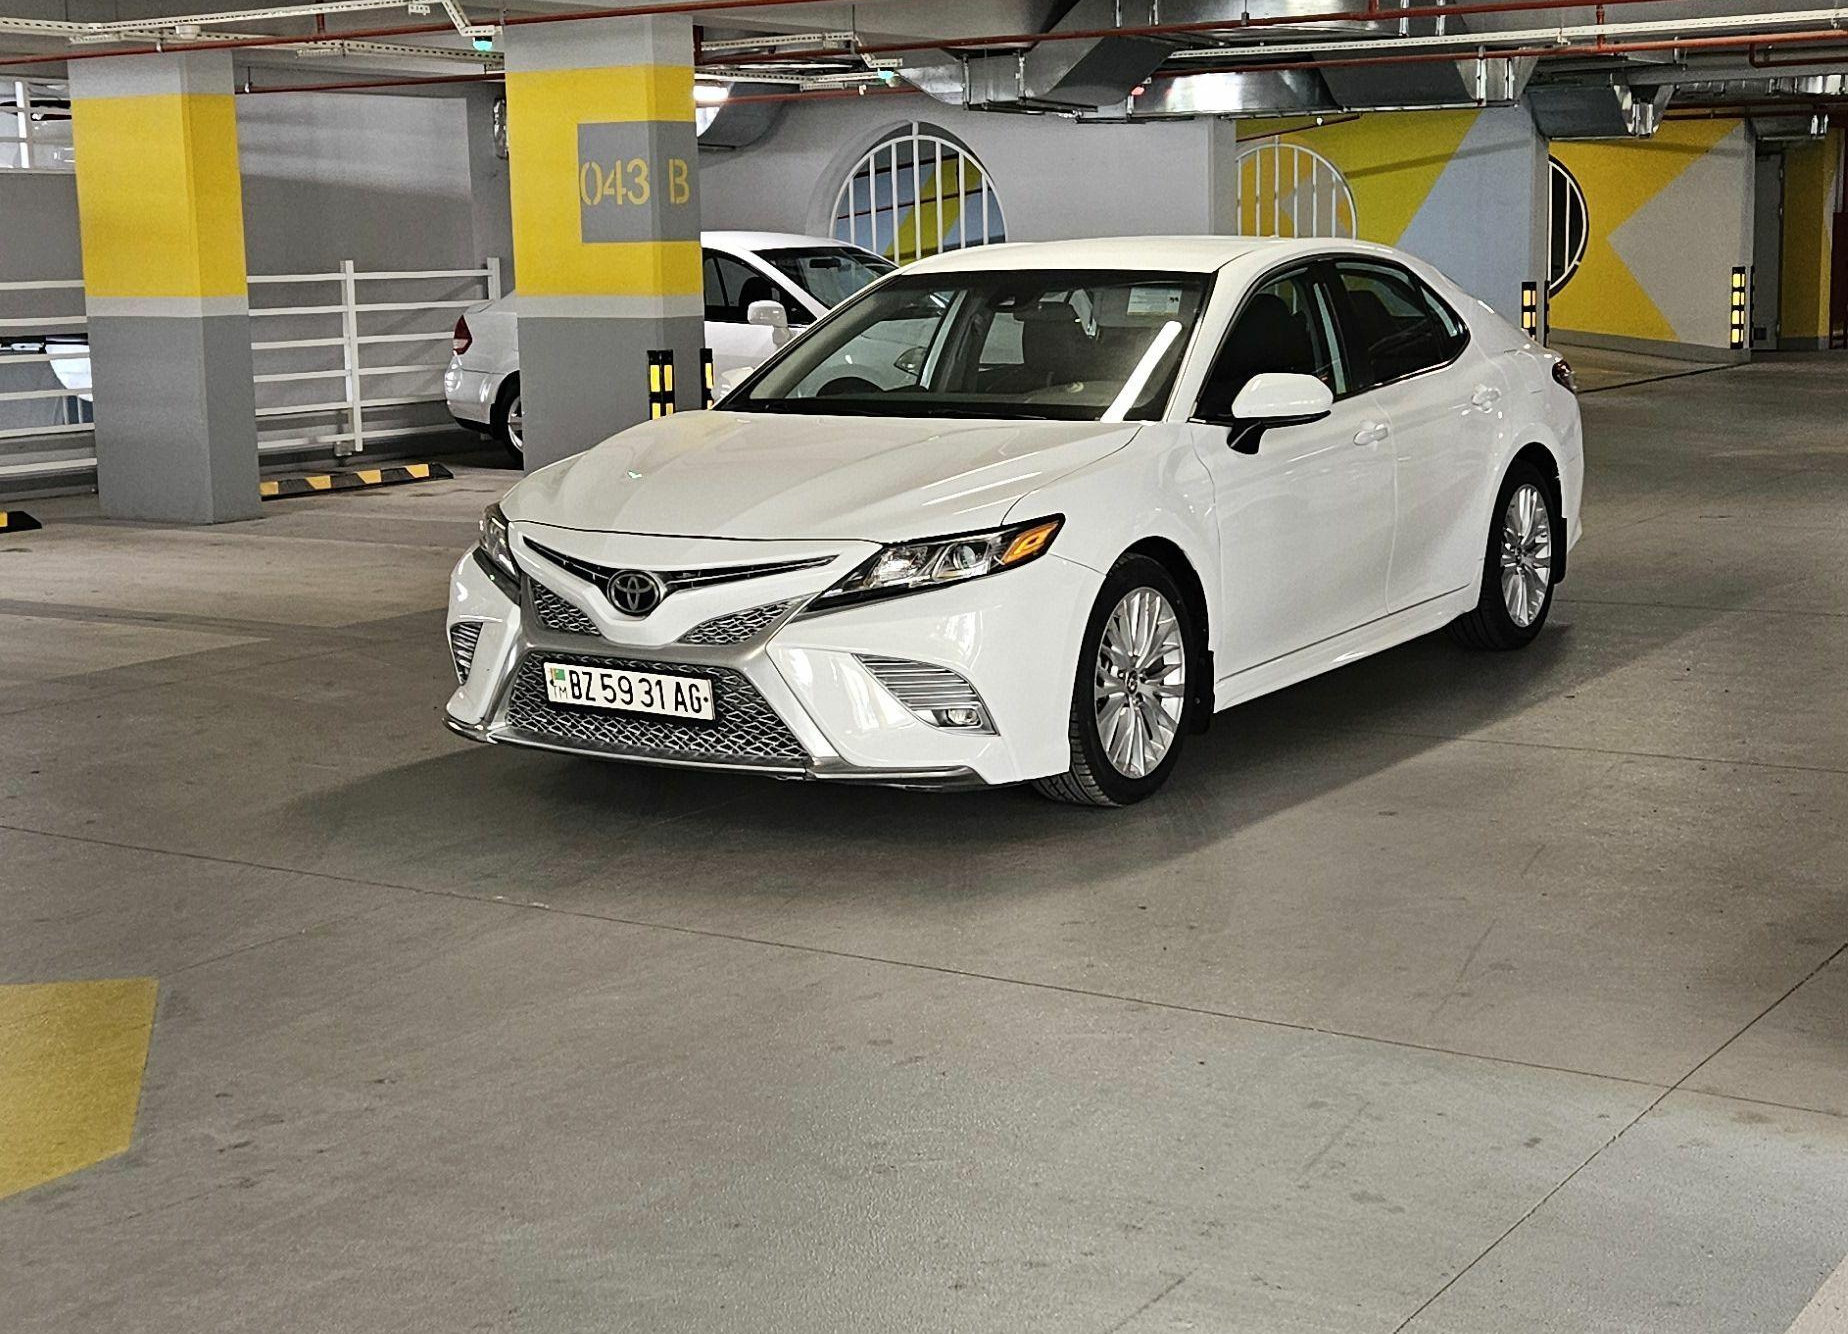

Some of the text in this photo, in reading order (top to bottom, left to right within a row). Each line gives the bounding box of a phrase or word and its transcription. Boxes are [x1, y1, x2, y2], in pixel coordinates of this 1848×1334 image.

[580, 158, 690, 205] 043 B
[569, 670, 596, 702] BZ
[674, 681, 702, 713] AG
